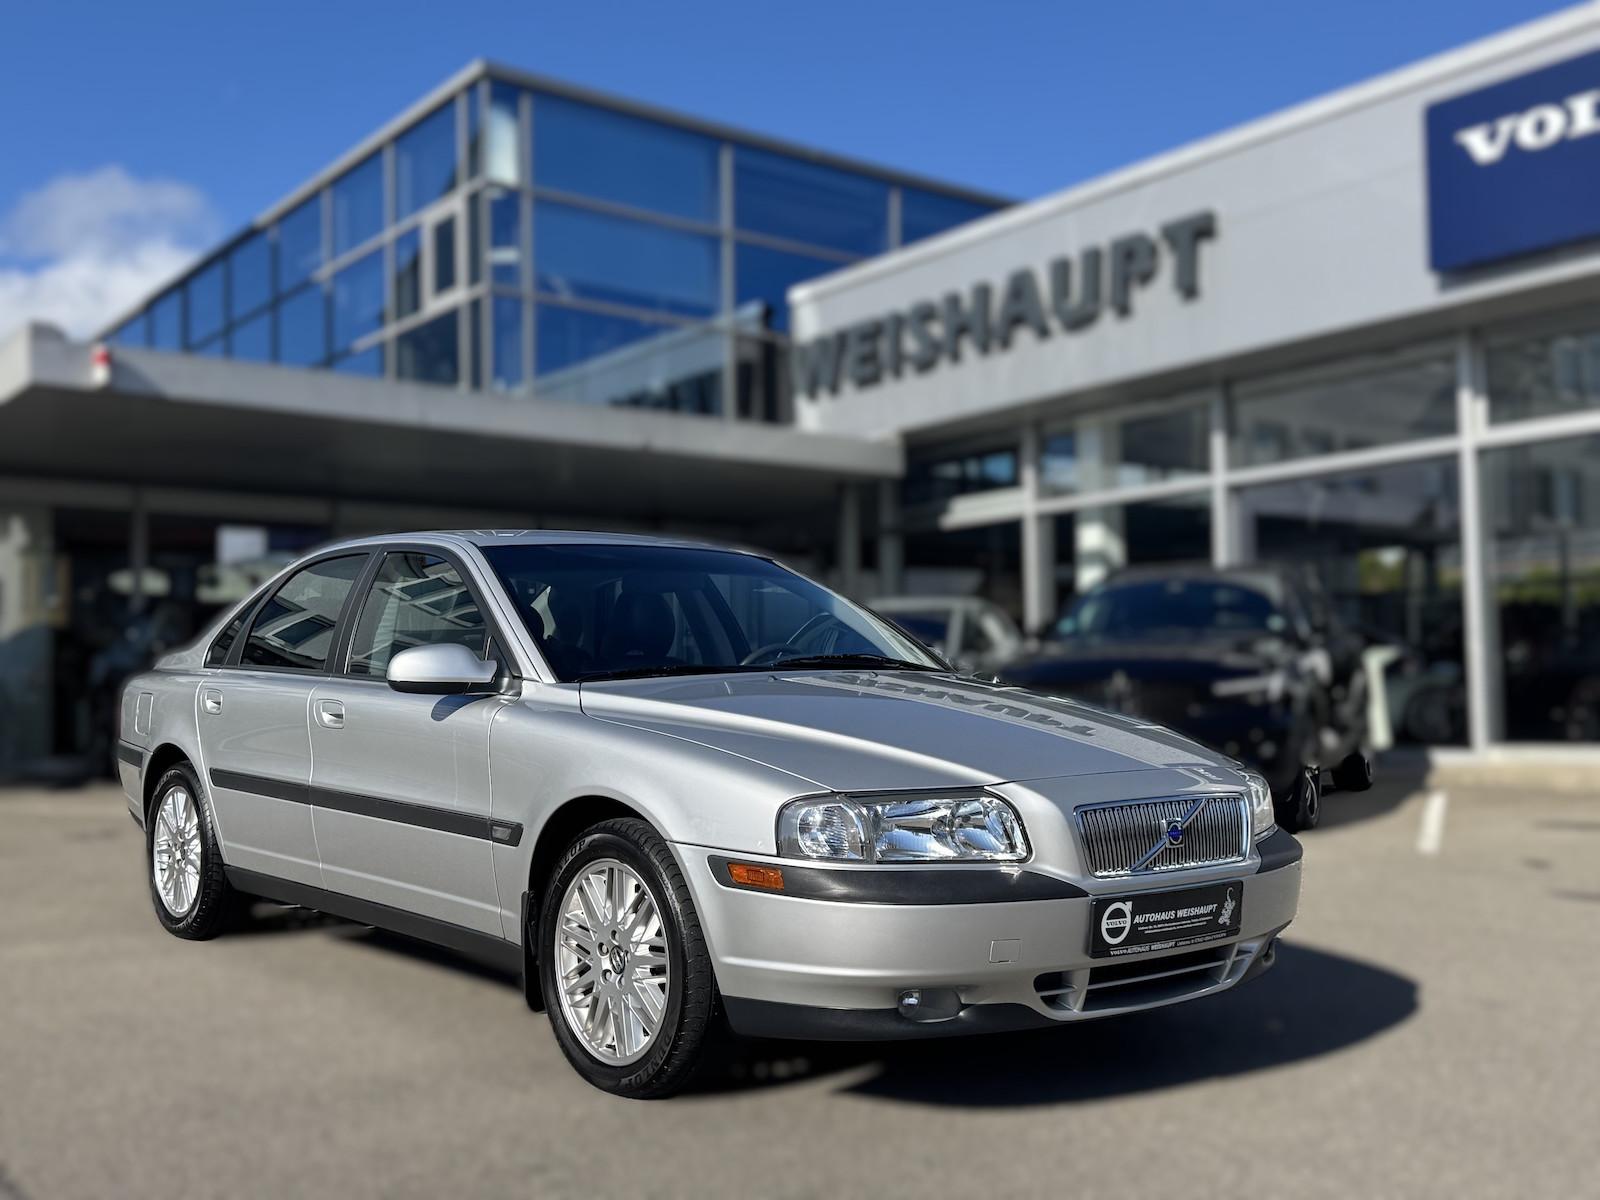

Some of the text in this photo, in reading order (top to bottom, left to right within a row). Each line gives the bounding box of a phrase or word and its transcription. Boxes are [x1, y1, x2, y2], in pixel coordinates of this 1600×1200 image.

[791, 209, 1217, 401] WEISHAUPT
[1106, 919, 1127, 927] VOLVO
[1133, 911, 1175, 924] AUTOHAUS
[1176, 903, 1217, 917] WEISHAUPT
